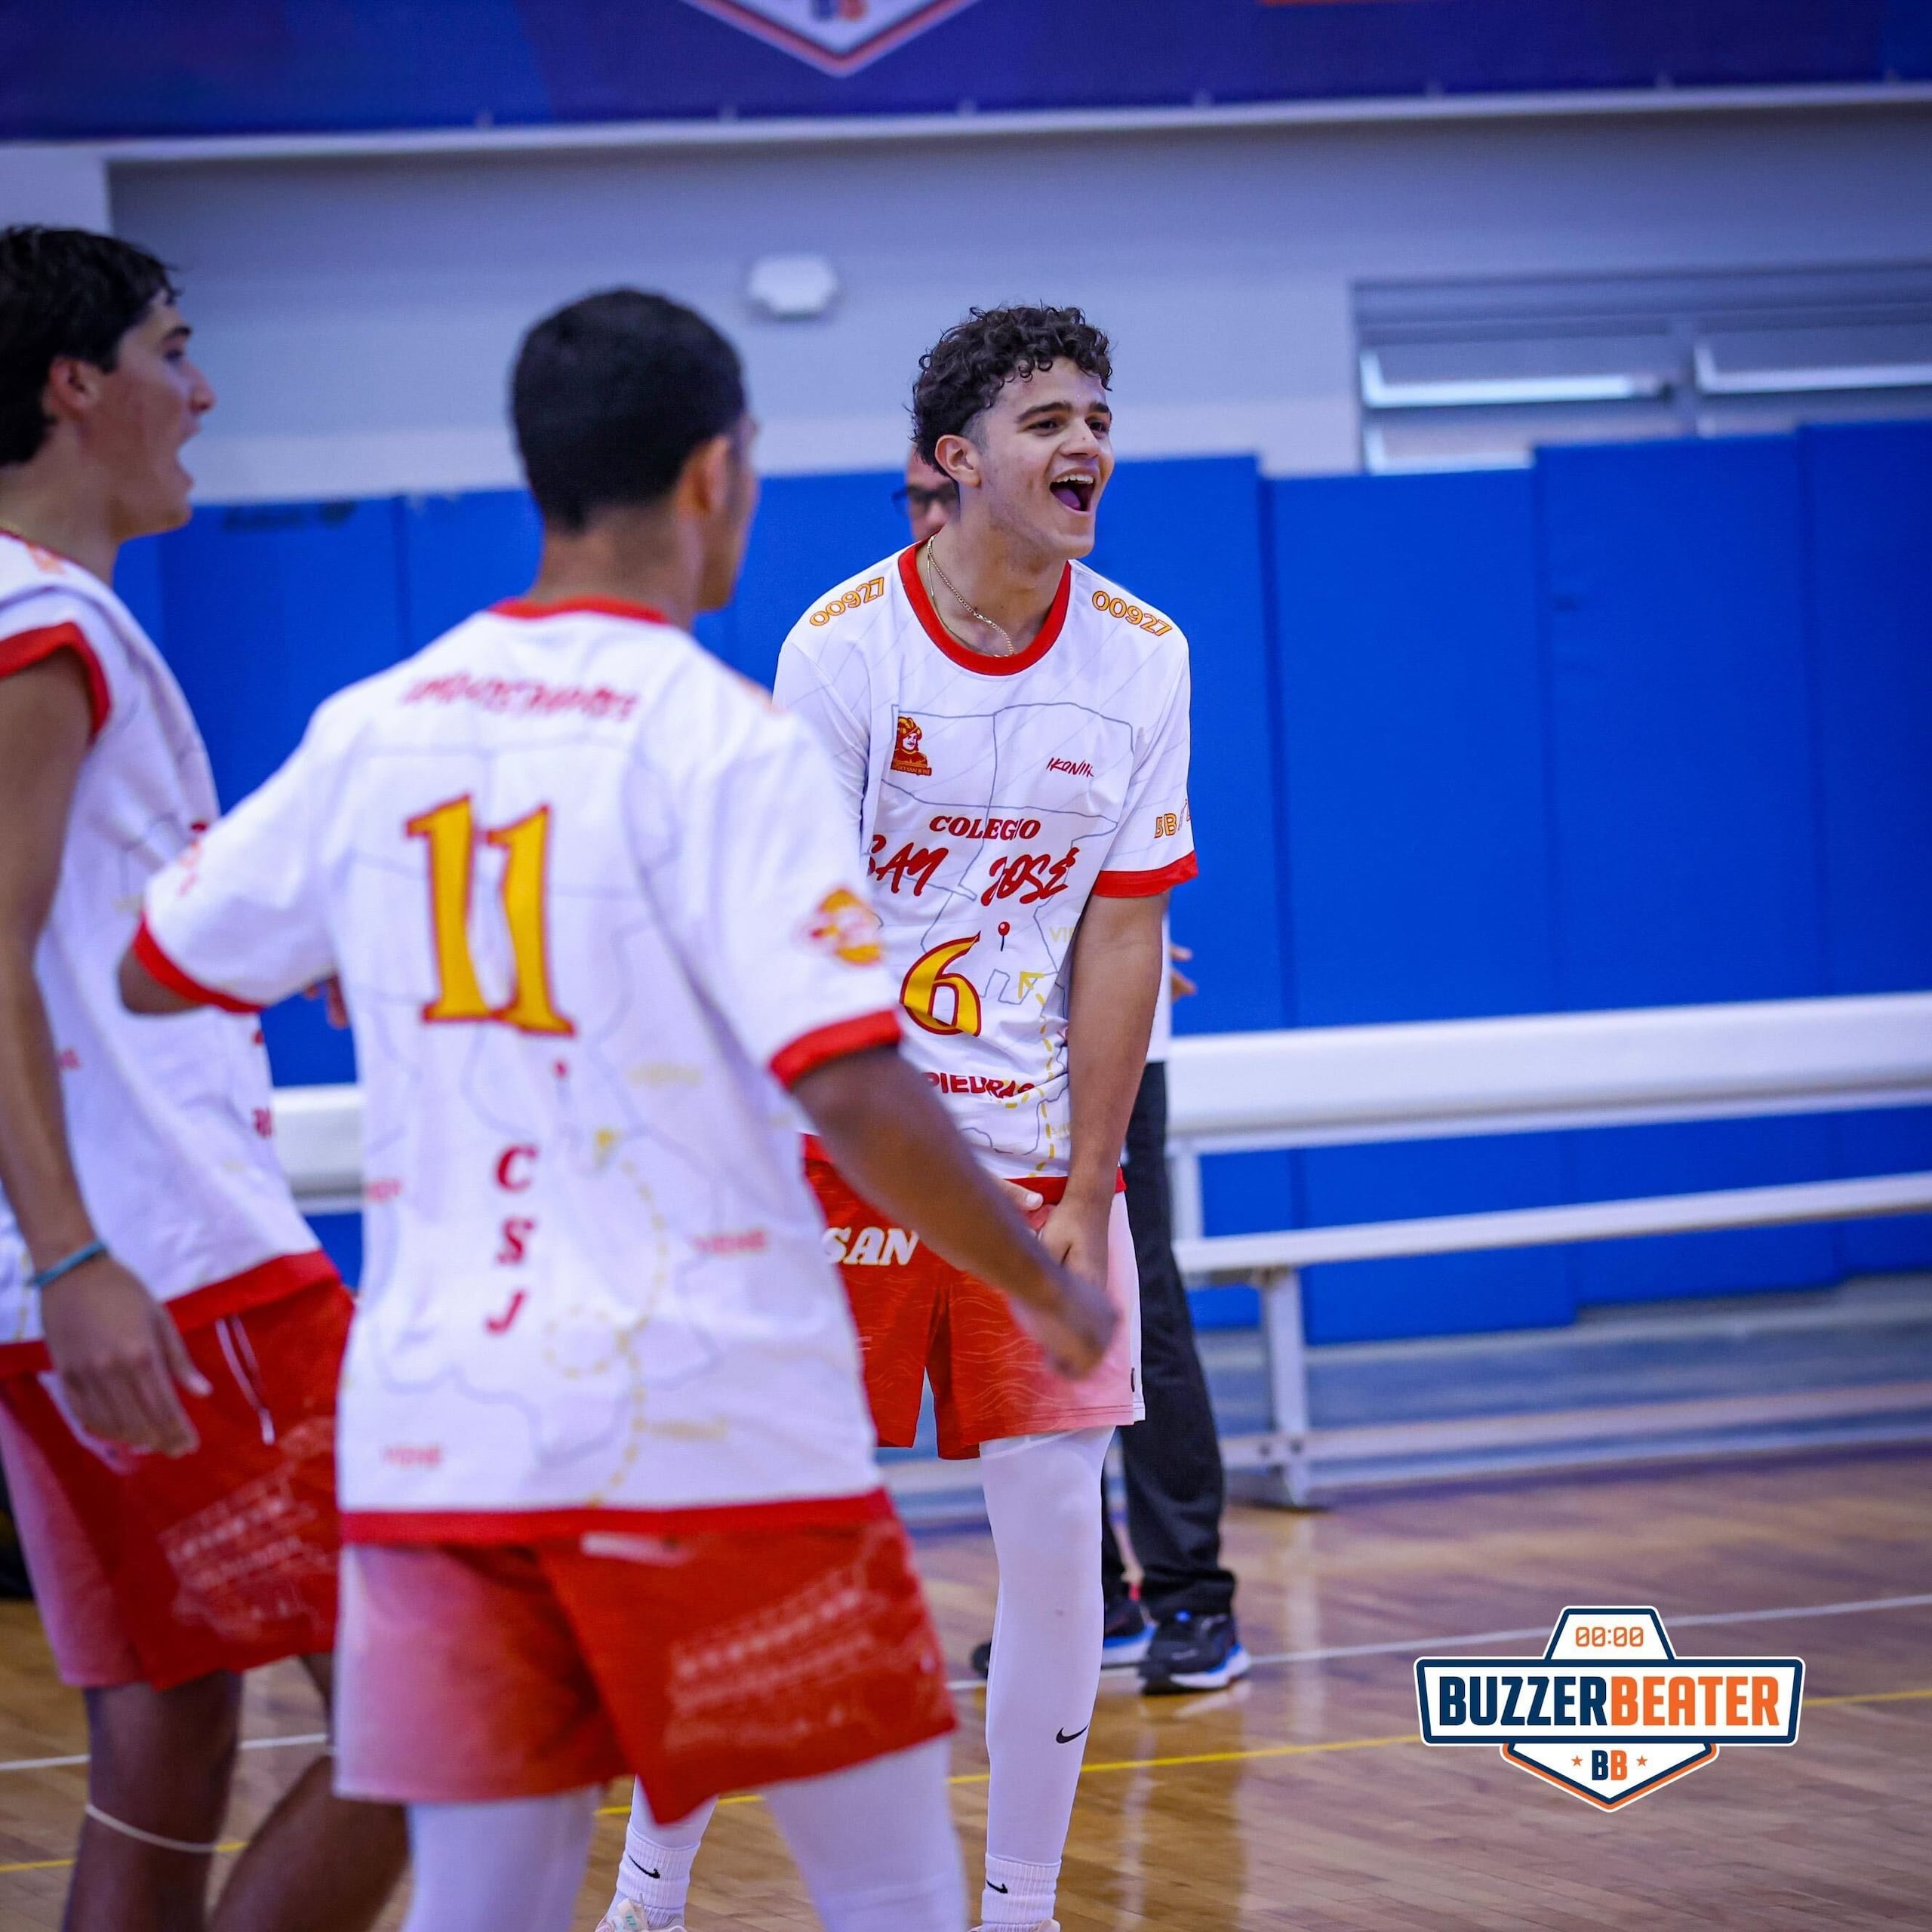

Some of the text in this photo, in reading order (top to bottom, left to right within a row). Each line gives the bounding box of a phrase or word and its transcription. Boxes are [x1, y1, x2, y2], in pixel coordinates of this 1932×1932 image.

[810, 577, 884, 626] 00927
[1092, 590, 1173, 636] 00927
[929, 816, 1041, 841] COLEGO
[406, 793, 577, 1038] 11
[900, 930, 981, 1038] 6
[823, 1226, 920, 1266] SAN
